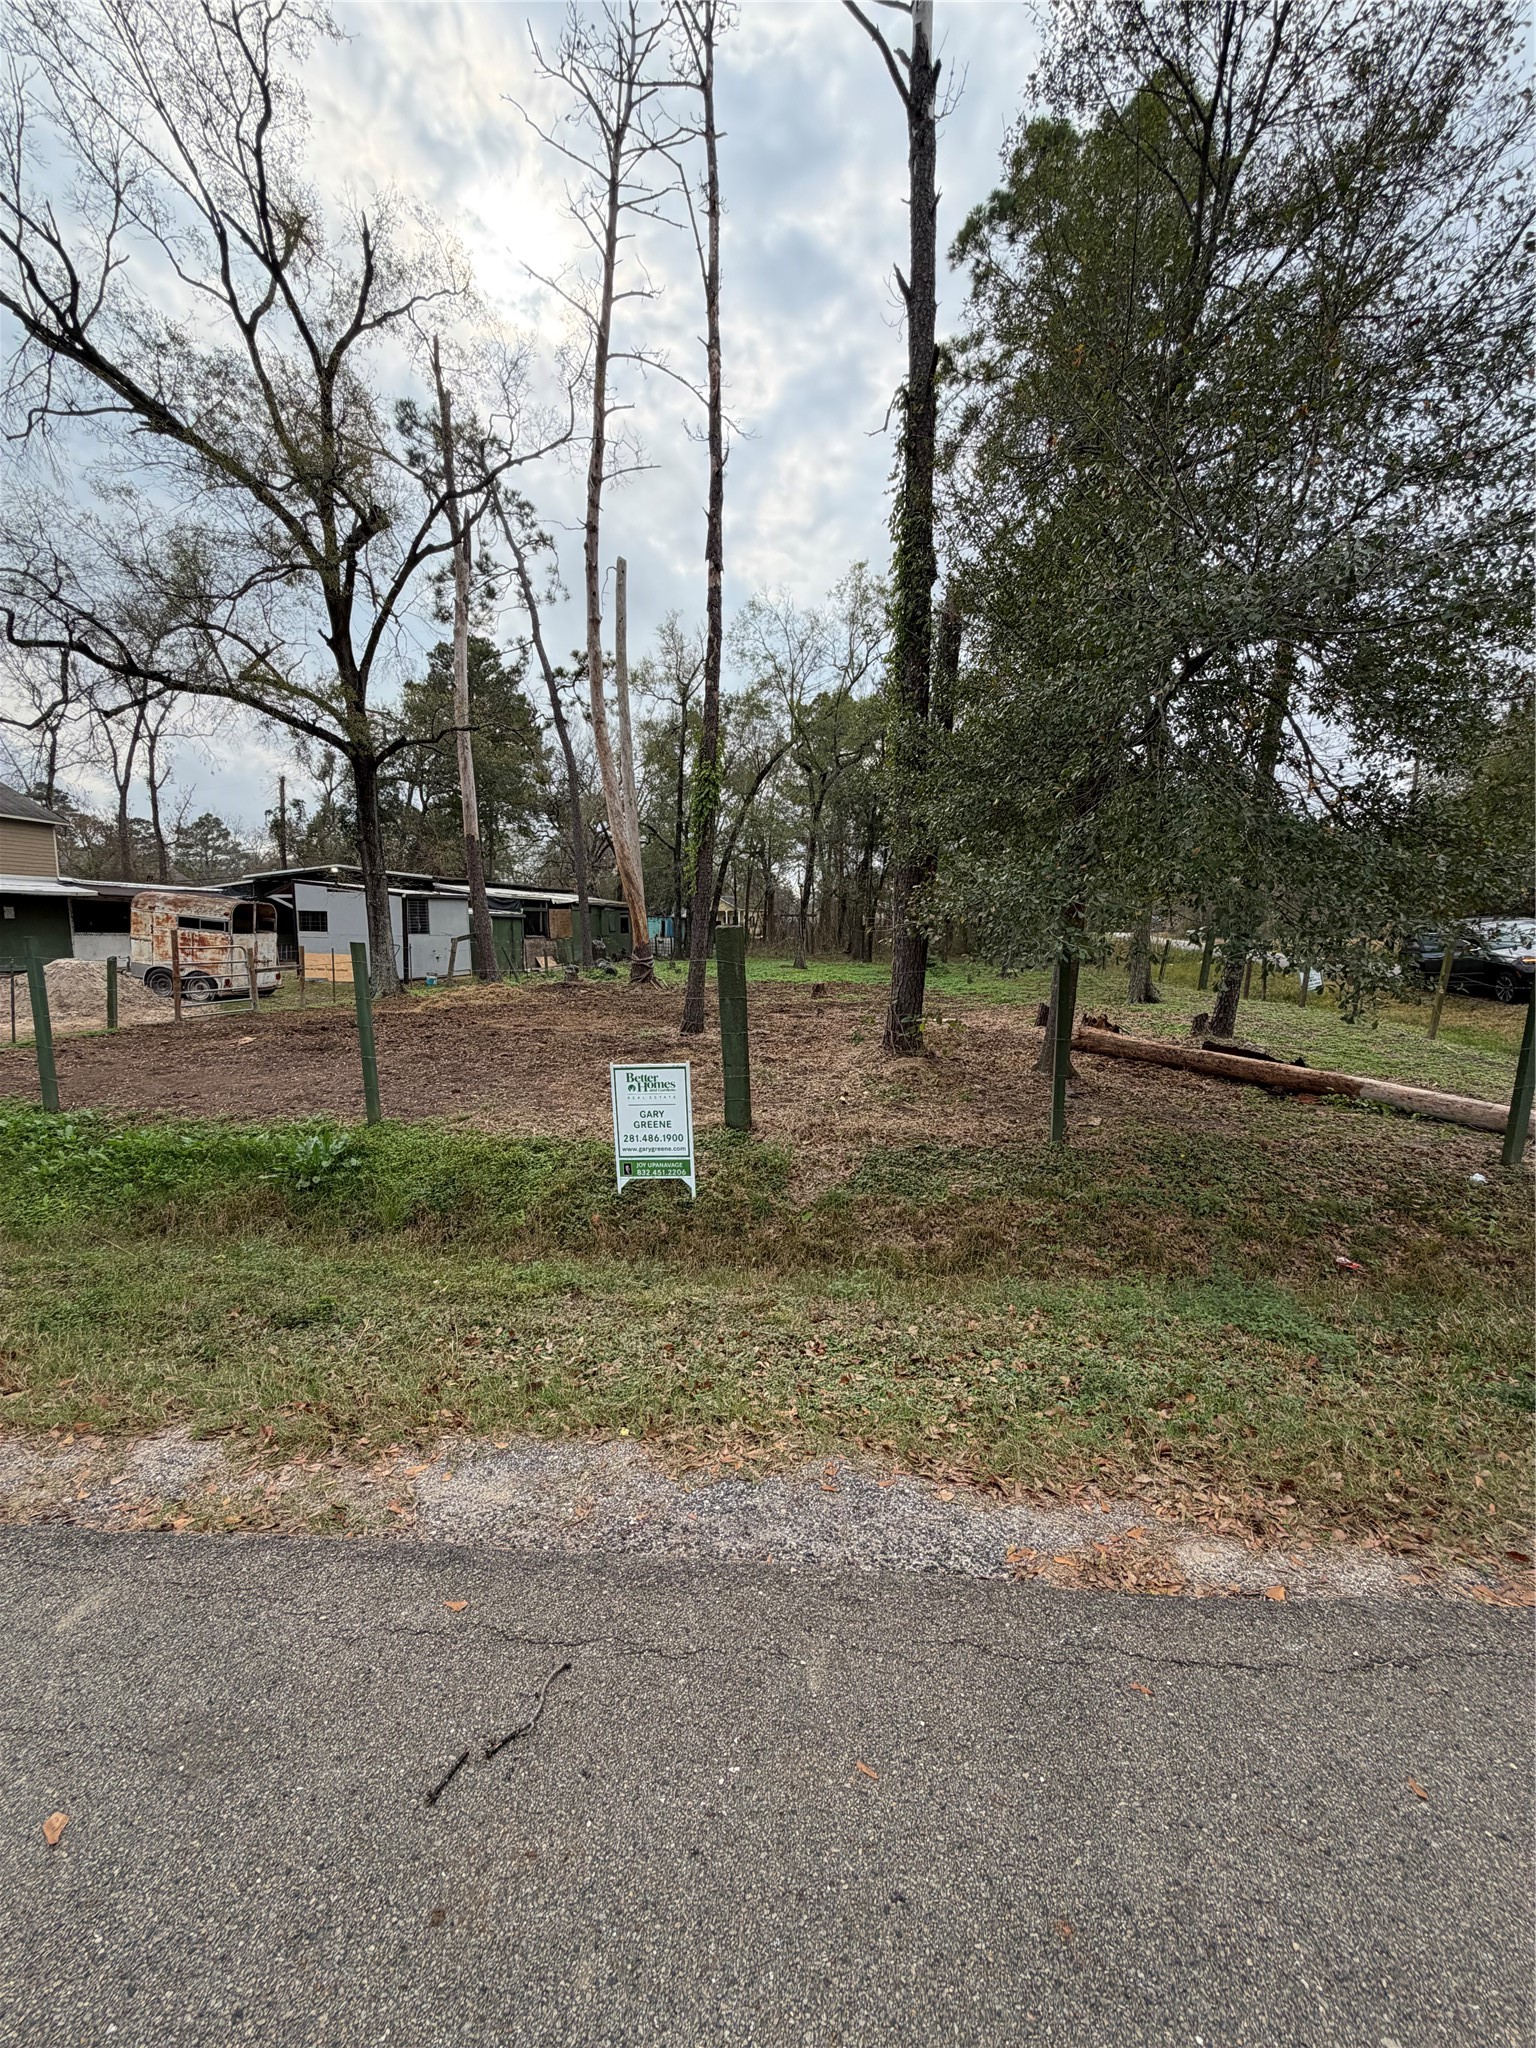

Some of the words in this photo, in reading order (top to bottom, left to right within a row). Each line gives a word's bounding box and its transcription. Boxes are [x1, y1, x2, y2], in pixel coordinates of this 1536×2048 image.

[626, 1072, 659, 1083] Better
[638, 1080, 676, 1092] Homes
[639, 1110, 665, 1119] GARY
[633, 1120, 672, 1129] GREENE
[623, 1133, 684, 1143] 281.486.1900
